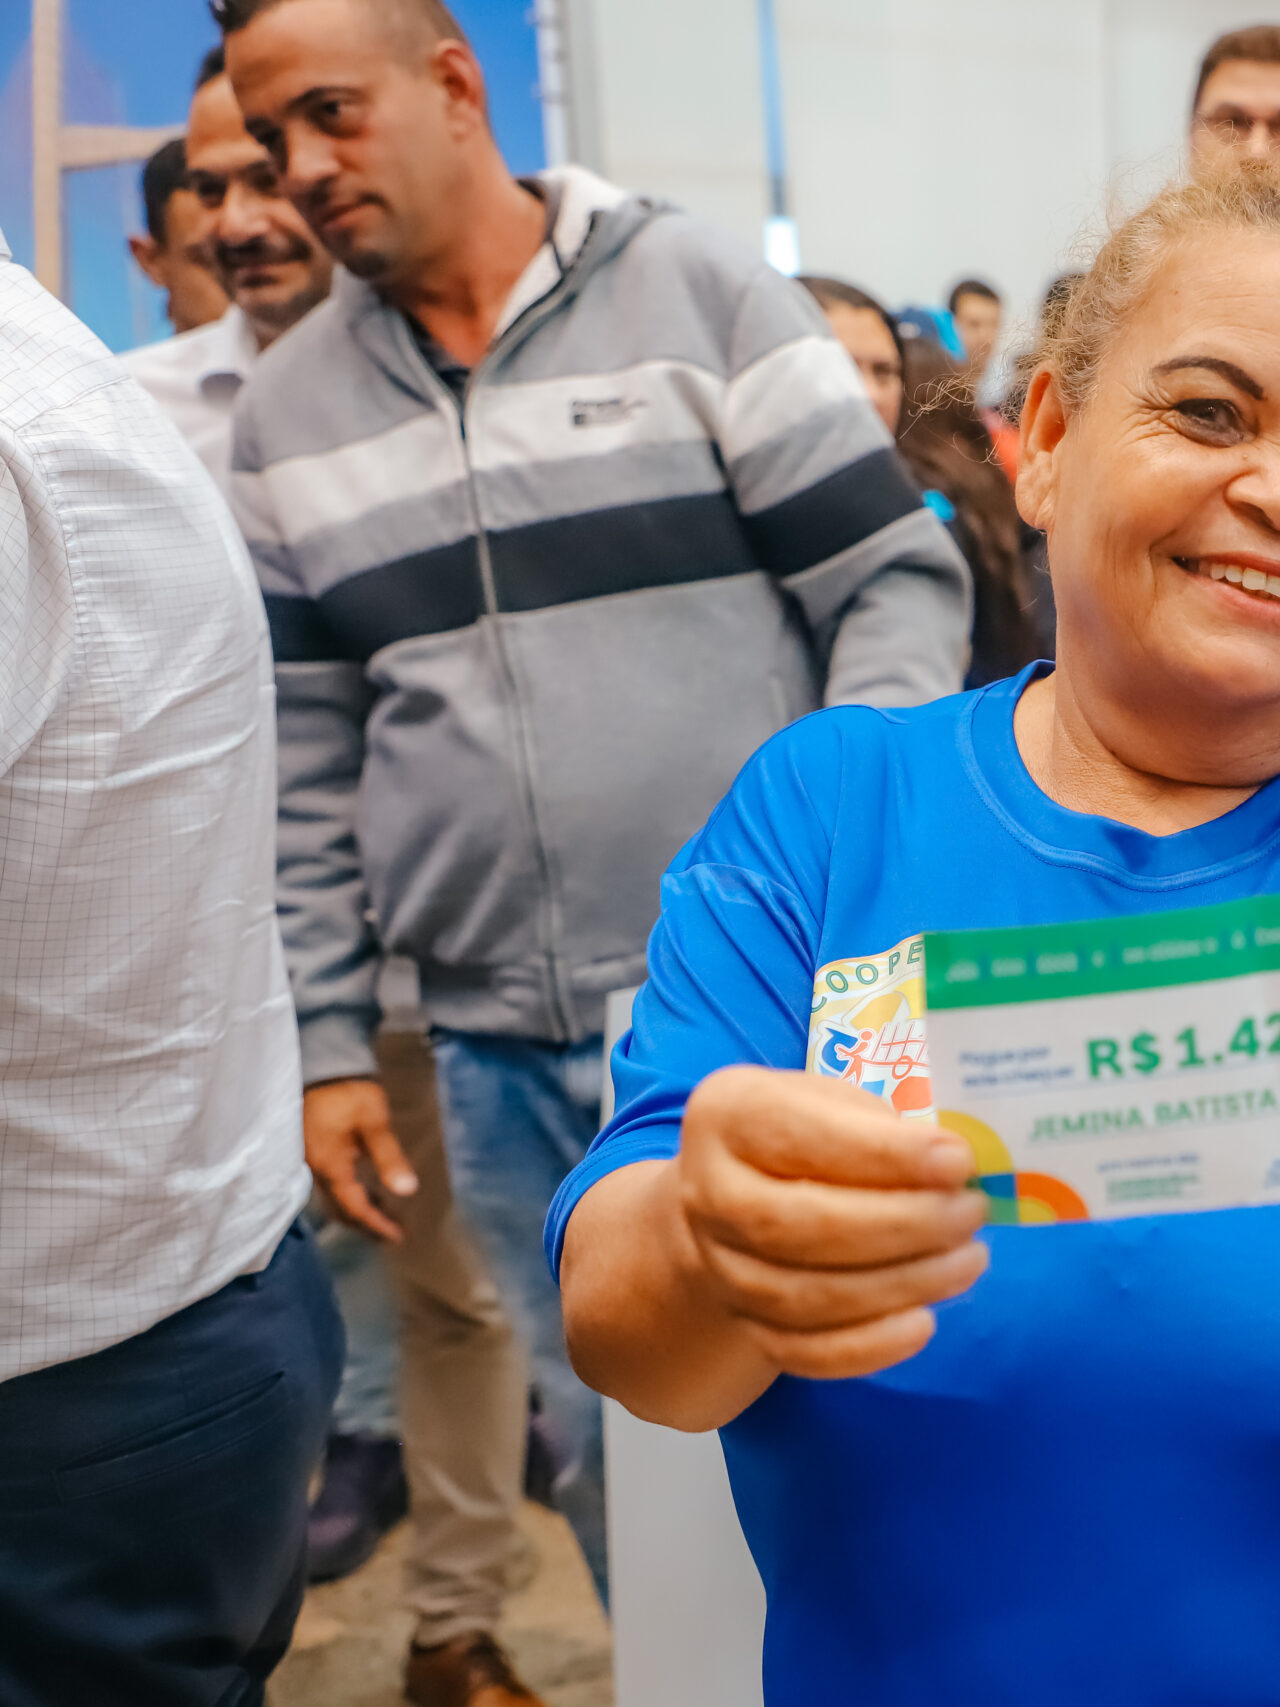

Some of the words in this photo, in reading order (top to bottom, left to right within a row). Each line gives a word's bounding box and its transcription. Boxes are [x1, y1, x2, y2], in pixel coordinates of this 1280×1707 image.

[1086, 1032, 1161, 1079] R$
[1029, 1108, 1145, 1142] JEMINA
[1153, 1088, 1278, 1126] BATISTA
